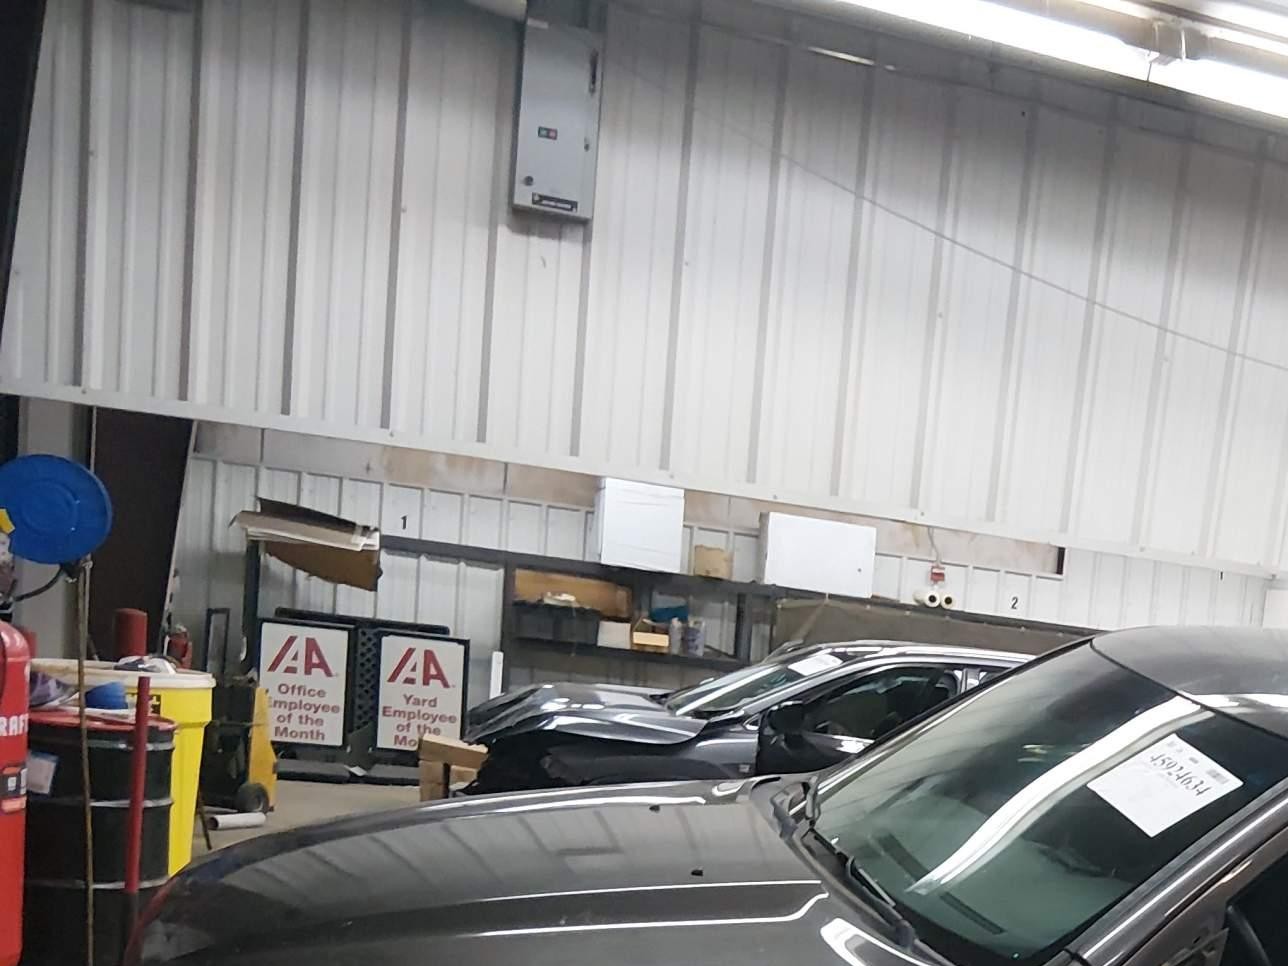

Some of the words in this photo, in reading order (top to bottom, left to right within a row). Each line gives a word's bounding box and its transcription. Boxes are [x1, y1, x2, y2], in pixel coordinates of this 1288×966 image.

[401, 515, 407, 530] 1
[1011, 596, 1019, 610] 2
[277, 683, 327, 698] Office
[403, 694, 438, 708] Yard
[276, 712, 292, 724] of
[298, 714, 324, 727] the
[382, 706, 457, 724] Employee
[274, 726, 325, 741] Month
[396, 721, 412, 732] of
[417, 724, 441, 736] the
[1150, 753, 1213, 797] 45924634
